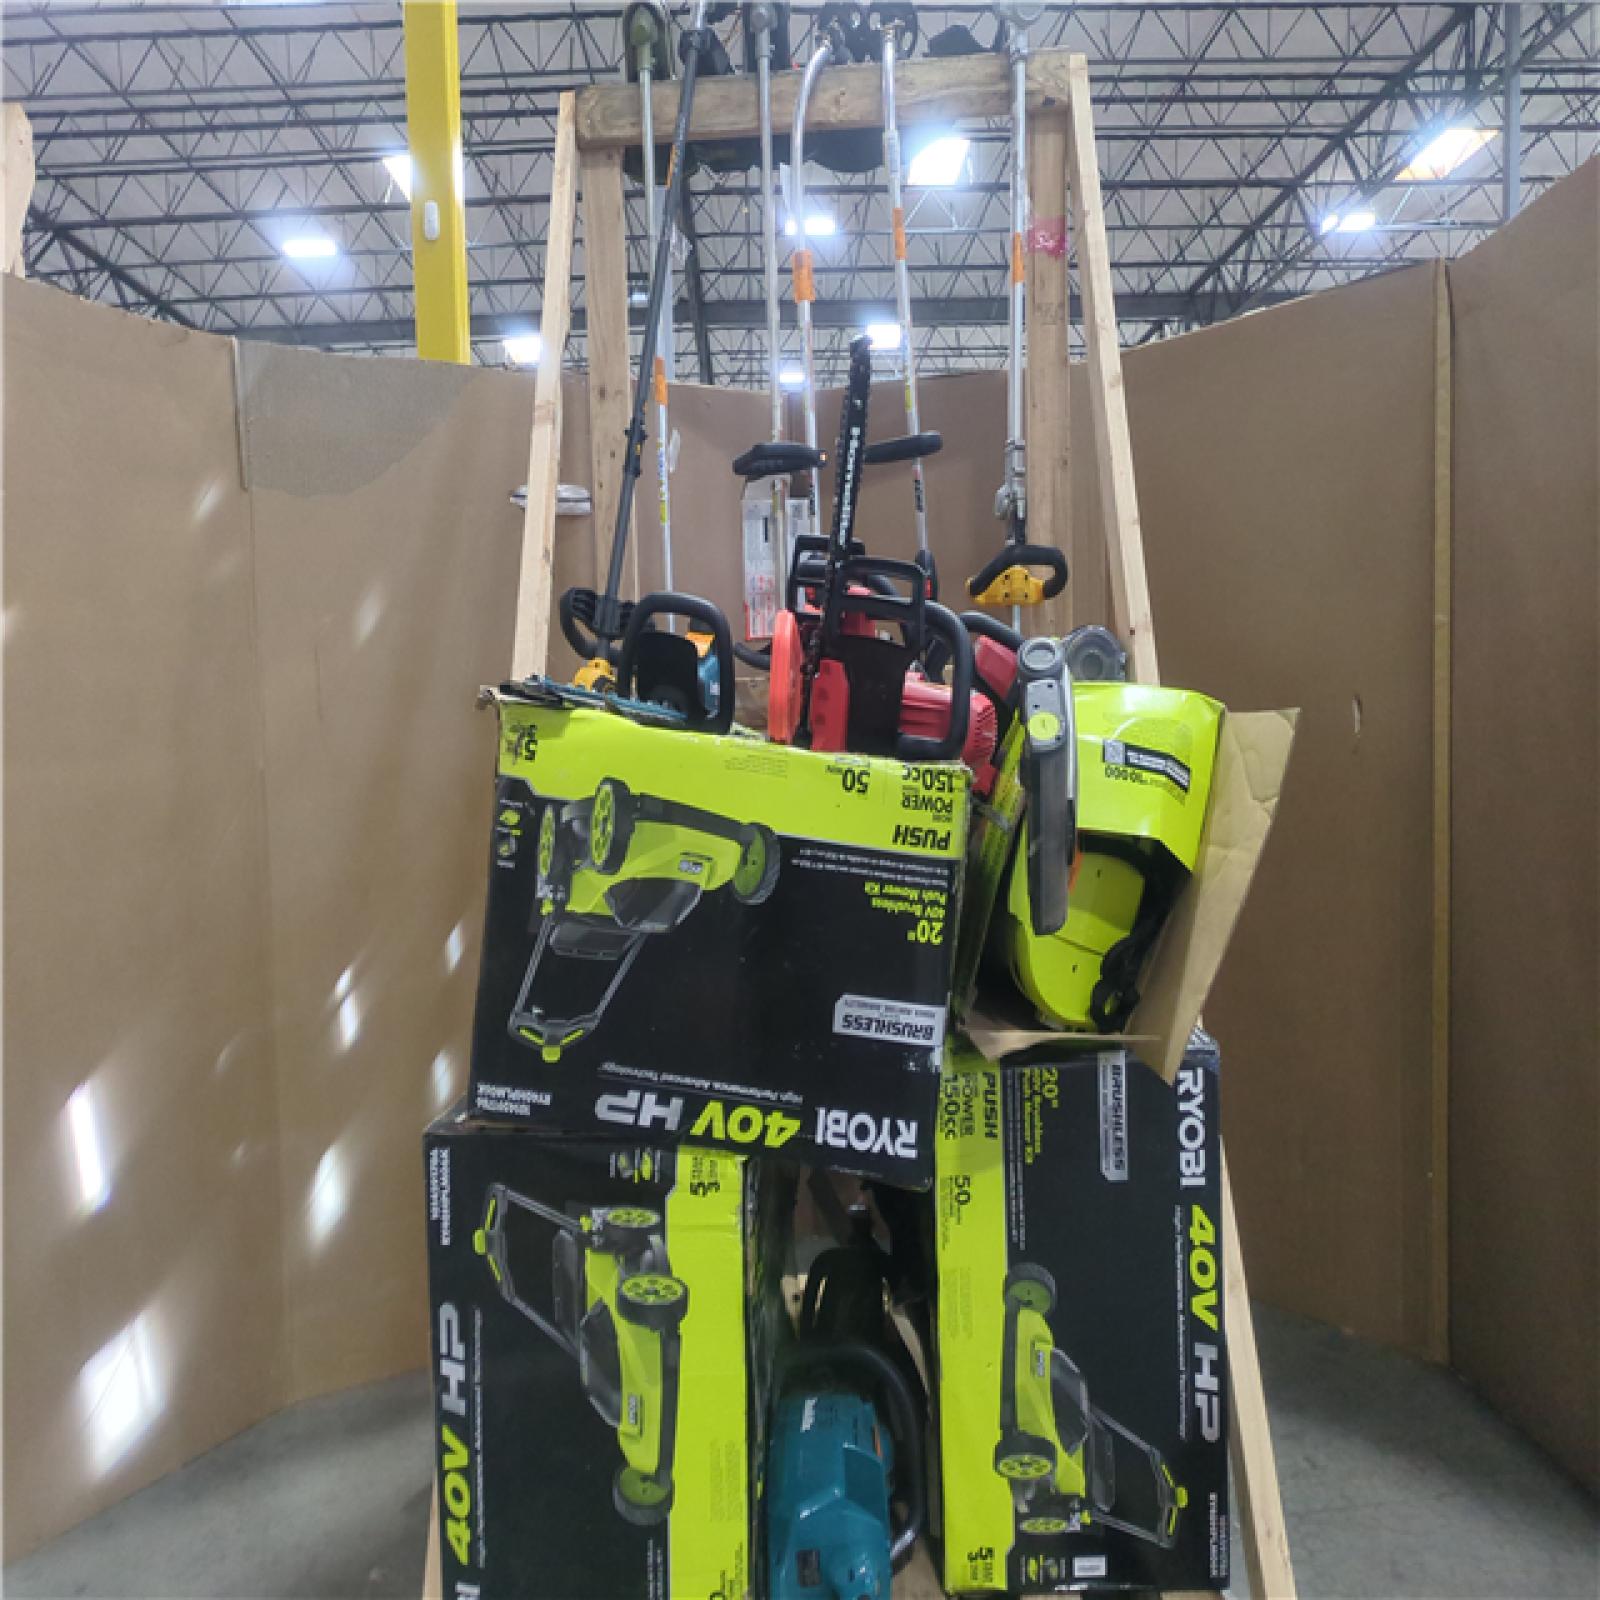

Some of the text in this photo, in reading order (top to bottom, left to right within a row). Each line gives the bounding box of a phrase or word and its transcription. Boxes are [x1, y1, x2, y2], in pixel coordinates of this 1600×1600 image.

[842, 768, 871, 794] 50
[901, 793, 954, 814] POWER
[892, 824, 952, 851] PUSH
[906, 919, 945, 946] 20"
[841, 1014, 934, 1041] BRUSHLESS
[944, 1072, 960, 1141] 150cc
[961, 1072, 975, 1136] POWER
[982, 1072, 999, 1140] PUSH
[1042, 1067, 1060, 1108] 20"
[1110, 1064, 1126, 1171] BRUSHLESS
[595, 1089, 918, 1159] RYOBI 40V HP
[1177, 1066, 1206, 1187] RYOBI
[953, 1175, 971, 1206] 50
[1189, 1204, 1218, 1332] 40V
[438, 1302, 466, 1417] HP
[1194, 1342, 1221, 1443] HP
[441, 1424, 471, 1566] 40V
